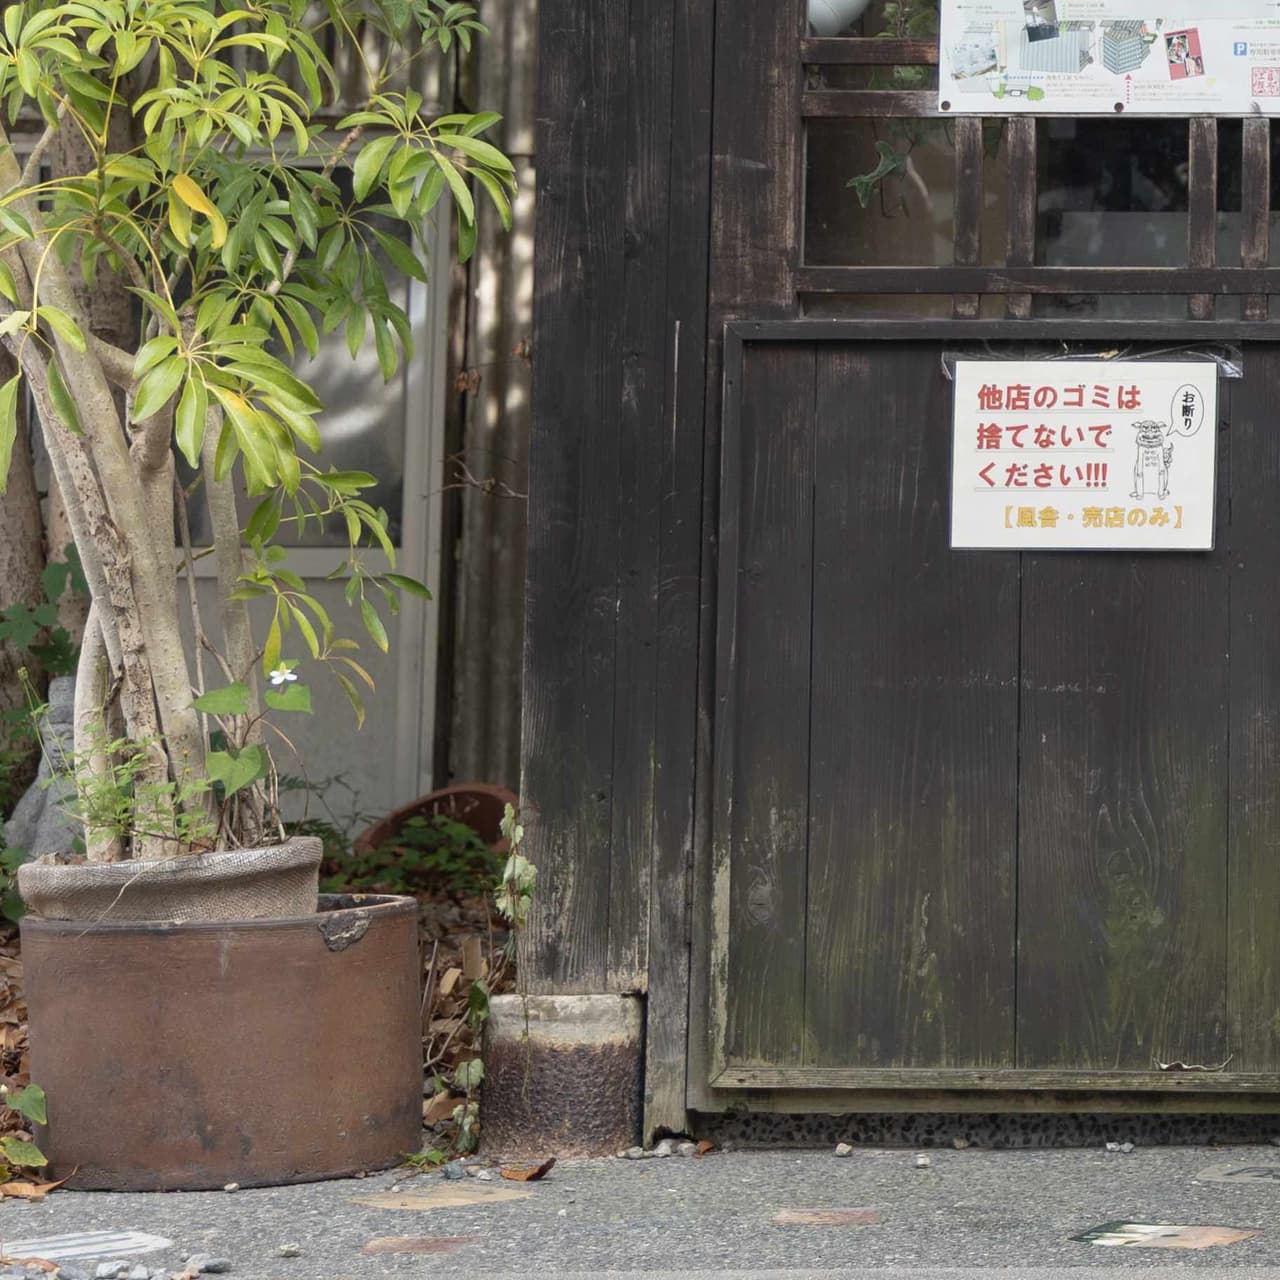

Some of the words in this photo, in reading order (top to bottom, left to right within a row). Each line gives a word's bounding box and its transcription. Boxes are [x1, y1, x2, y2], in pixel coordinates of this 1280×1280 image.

[977, 383, 1142, 411] 他店のゴミは
[1181, 391, 1196, 430] お断り
[976, 423, 1113, 450] 捨てないで
